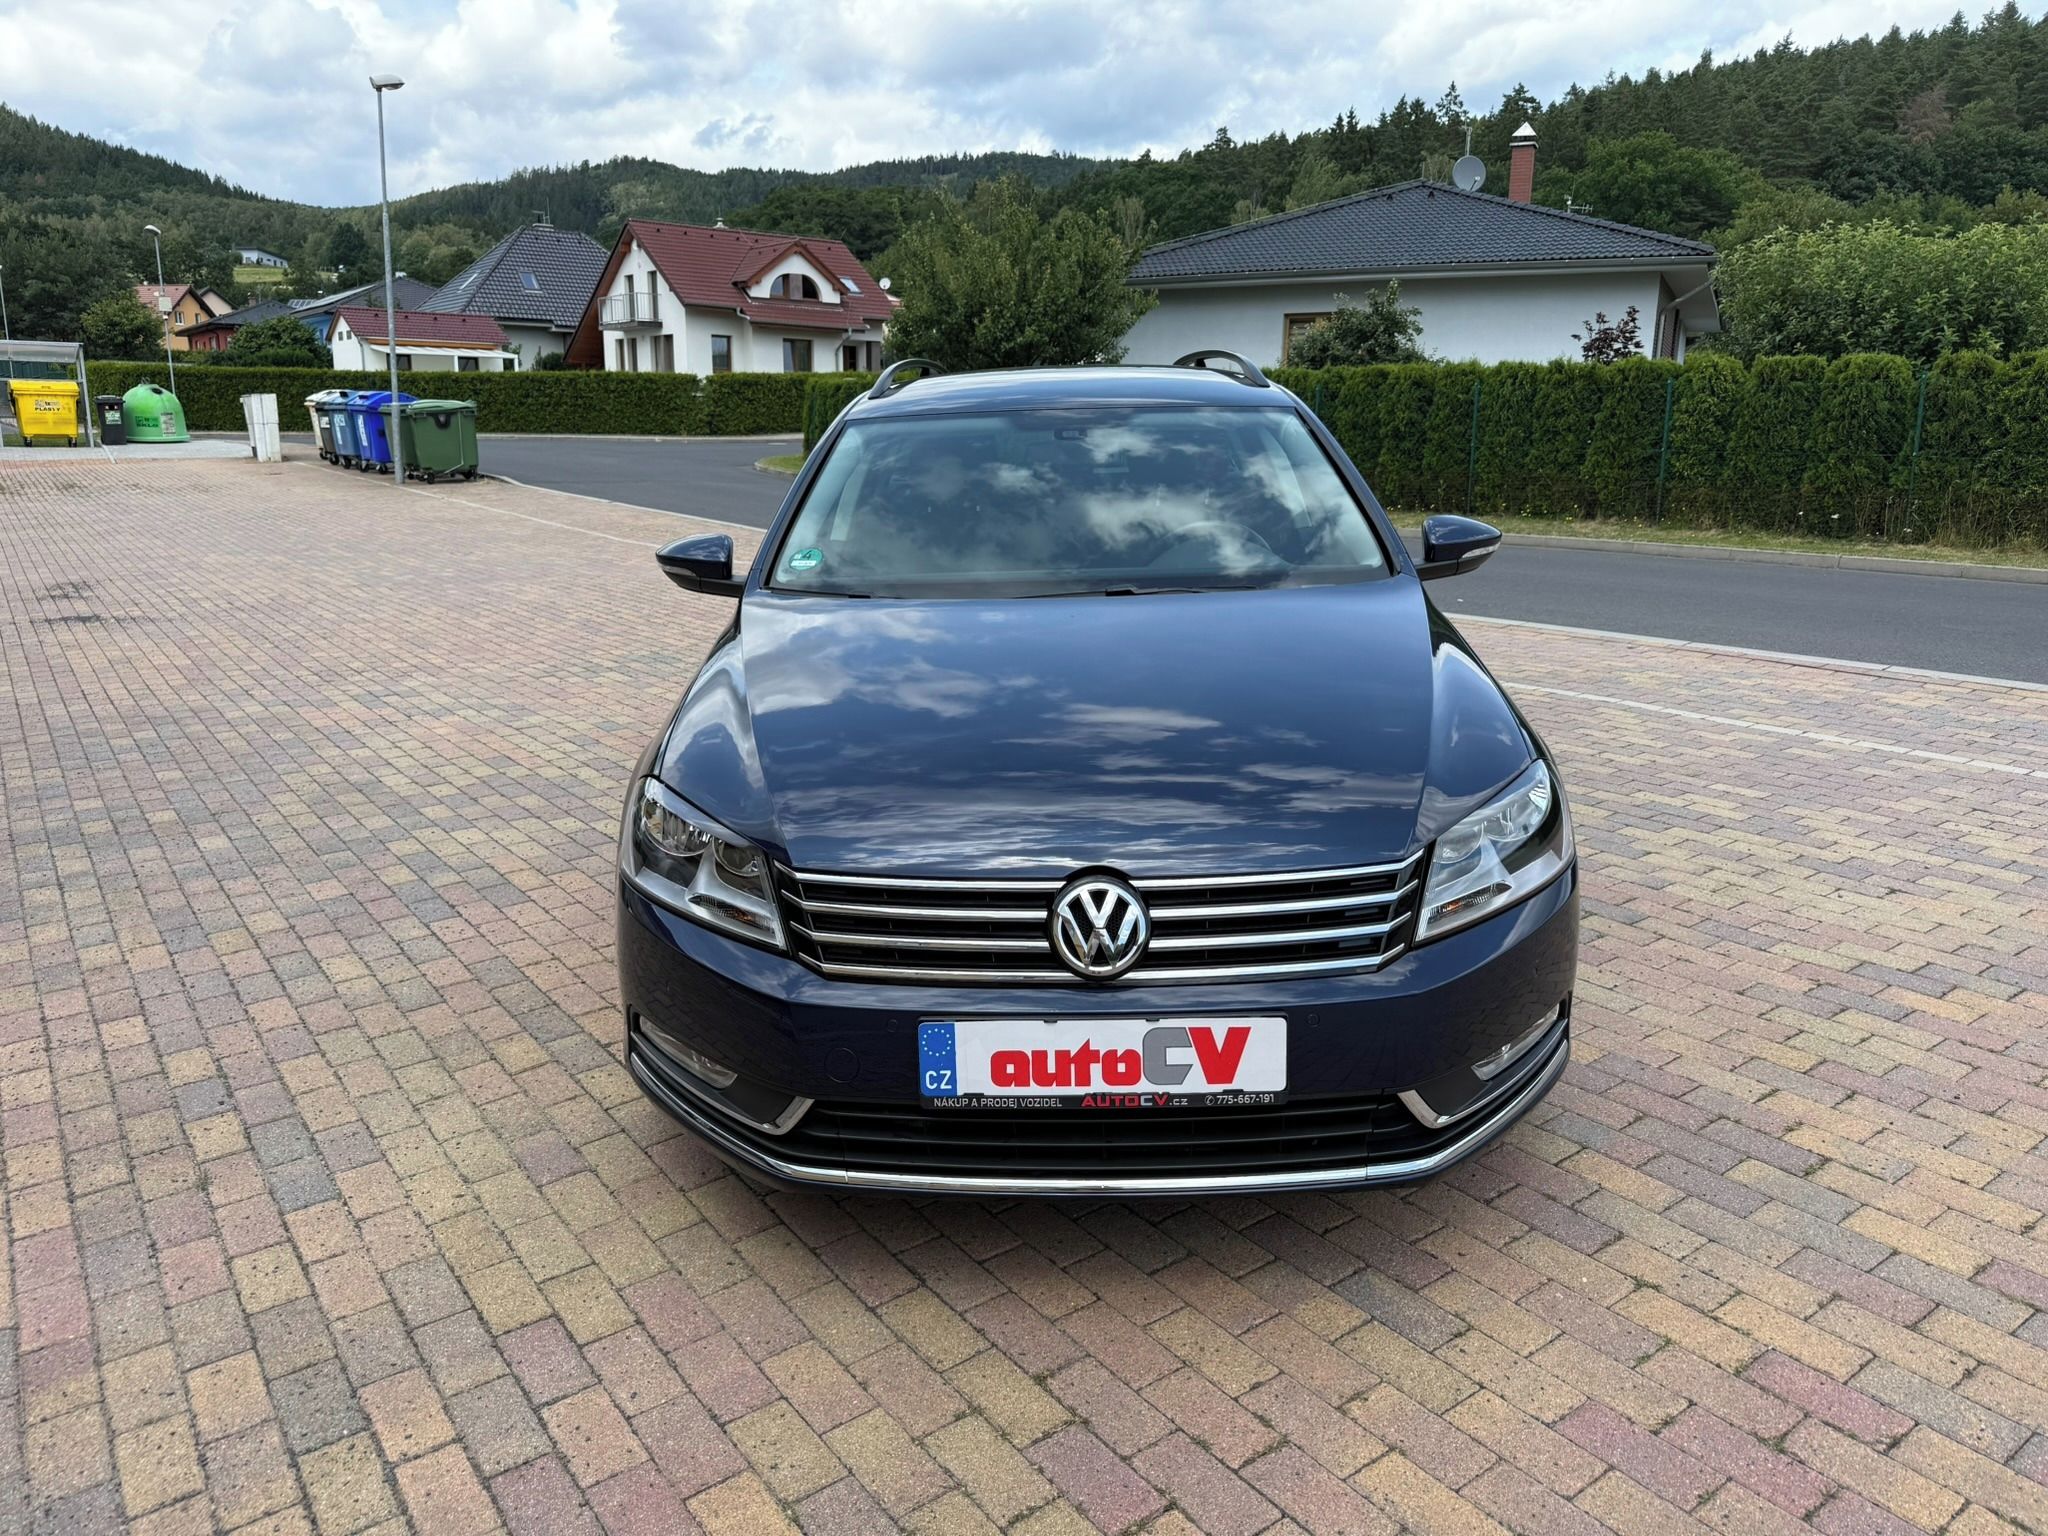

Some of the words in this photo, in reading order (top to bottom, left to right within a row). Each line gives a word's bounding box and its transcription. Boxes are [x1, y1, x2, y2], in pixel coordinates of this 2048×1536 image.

[990, 1026, 1251, 1087] autoCV
[925, 1070, 952, 1089] CZ
[934, 1096, 968, 1107] NÁKUP
[971, 1098, 978, 1106] A
[980, 1098, 1017, 1108] PRODEJ
[1020, 1098, 1062, 1107] VOZIDEL
[1216, 1094, 1274, 1104] 775-667-191
